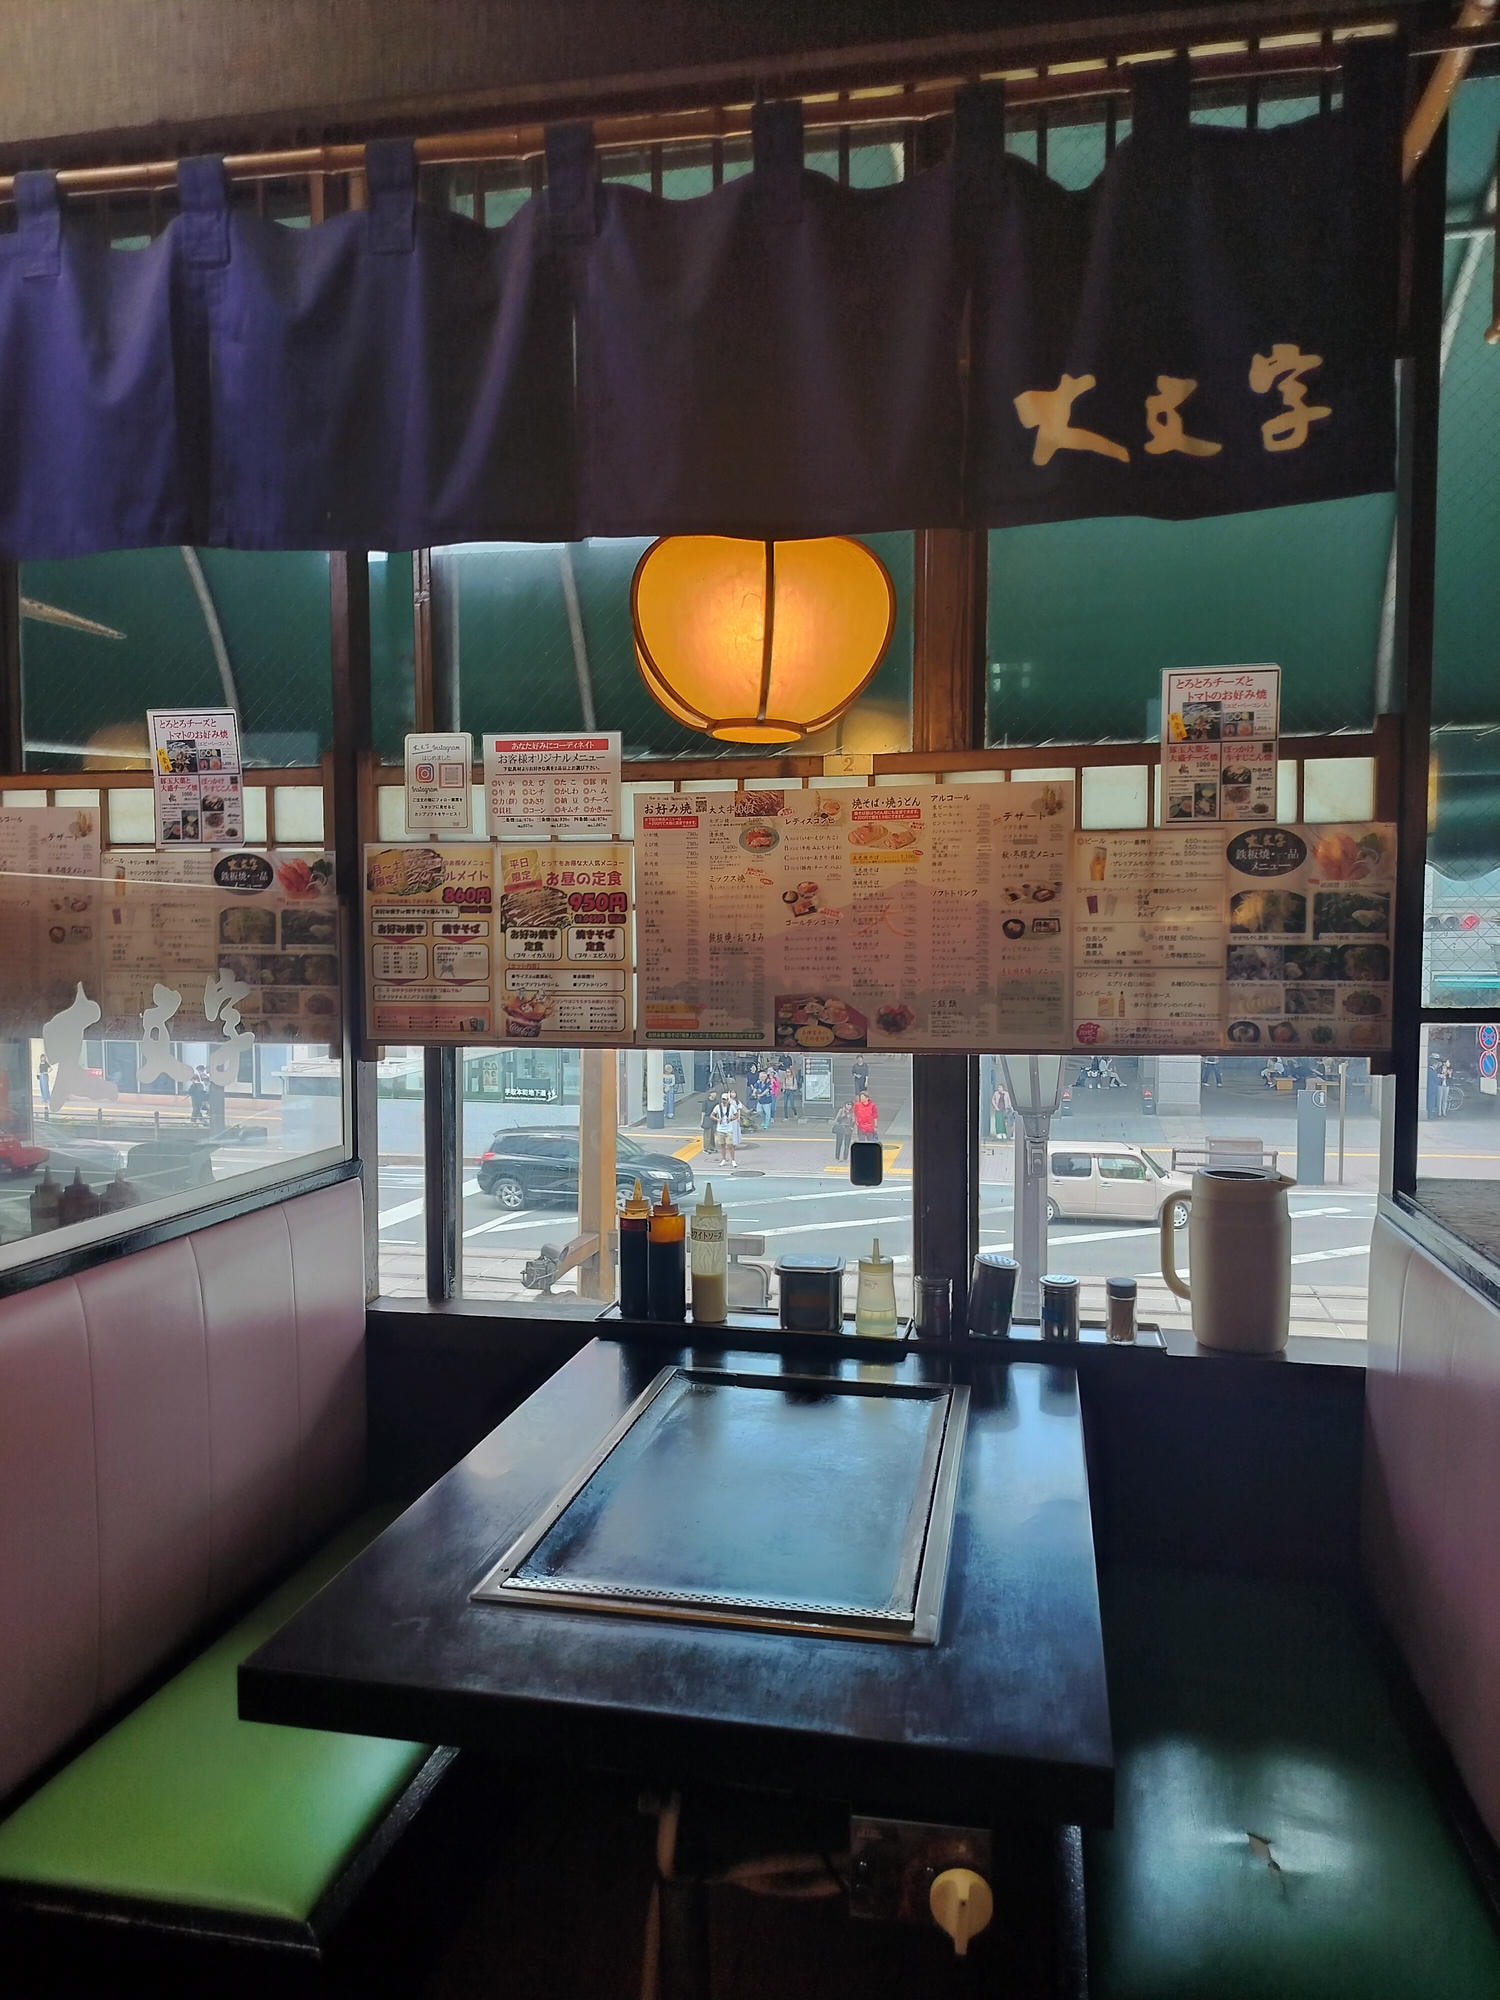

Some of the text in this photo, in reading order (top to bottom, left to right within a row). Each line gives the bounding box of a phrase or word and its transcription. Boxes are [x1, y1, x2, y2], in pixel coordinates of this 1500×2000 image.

[1176, 676, 1254, 688] とろとろチーズと
[1187, 689, 1268, 702] トマトのお好み焼
[160, 718, 216, 728] とろとろチーズと
[169, 729, 229, 740] トマトのお好み焼
[511, 740, 595, 750] あなた好みにコーディネイト
[498, 753, 606, 764] お客様オリジナルメニュー
[843, 757, 855, 771] 2
[851, 797, 921, 809] 焼そば・焼うどん
[930, 794, 971, 802] アルコール
[644, 802, 692, 815] お好み焼
[1003, 812, 1046, 821] デザート
[1235, 848, 1300, 860] 鉄板焼・一品
[509, 857, 529, 869] 平日
[1250, 862, 1292, 872] メニュー
[221, 871, 268, 881] 鉄板焼・一品
[546, 870, 622, 886] お昼の定食
[442, 886, 492, 904] 860円
[930, 889, 978, 897] ソフトドリンク
[568, 892, 628, 912] 950円
[378, 923, 481, 934] お好み焼き 焼きそば
[510, 929, 616, 940] お好み焼き 焼きそば
[709, 932, 764, 943] 鉄板焼・おつまみ
[524, 941, 606, 952] 定食 定食
